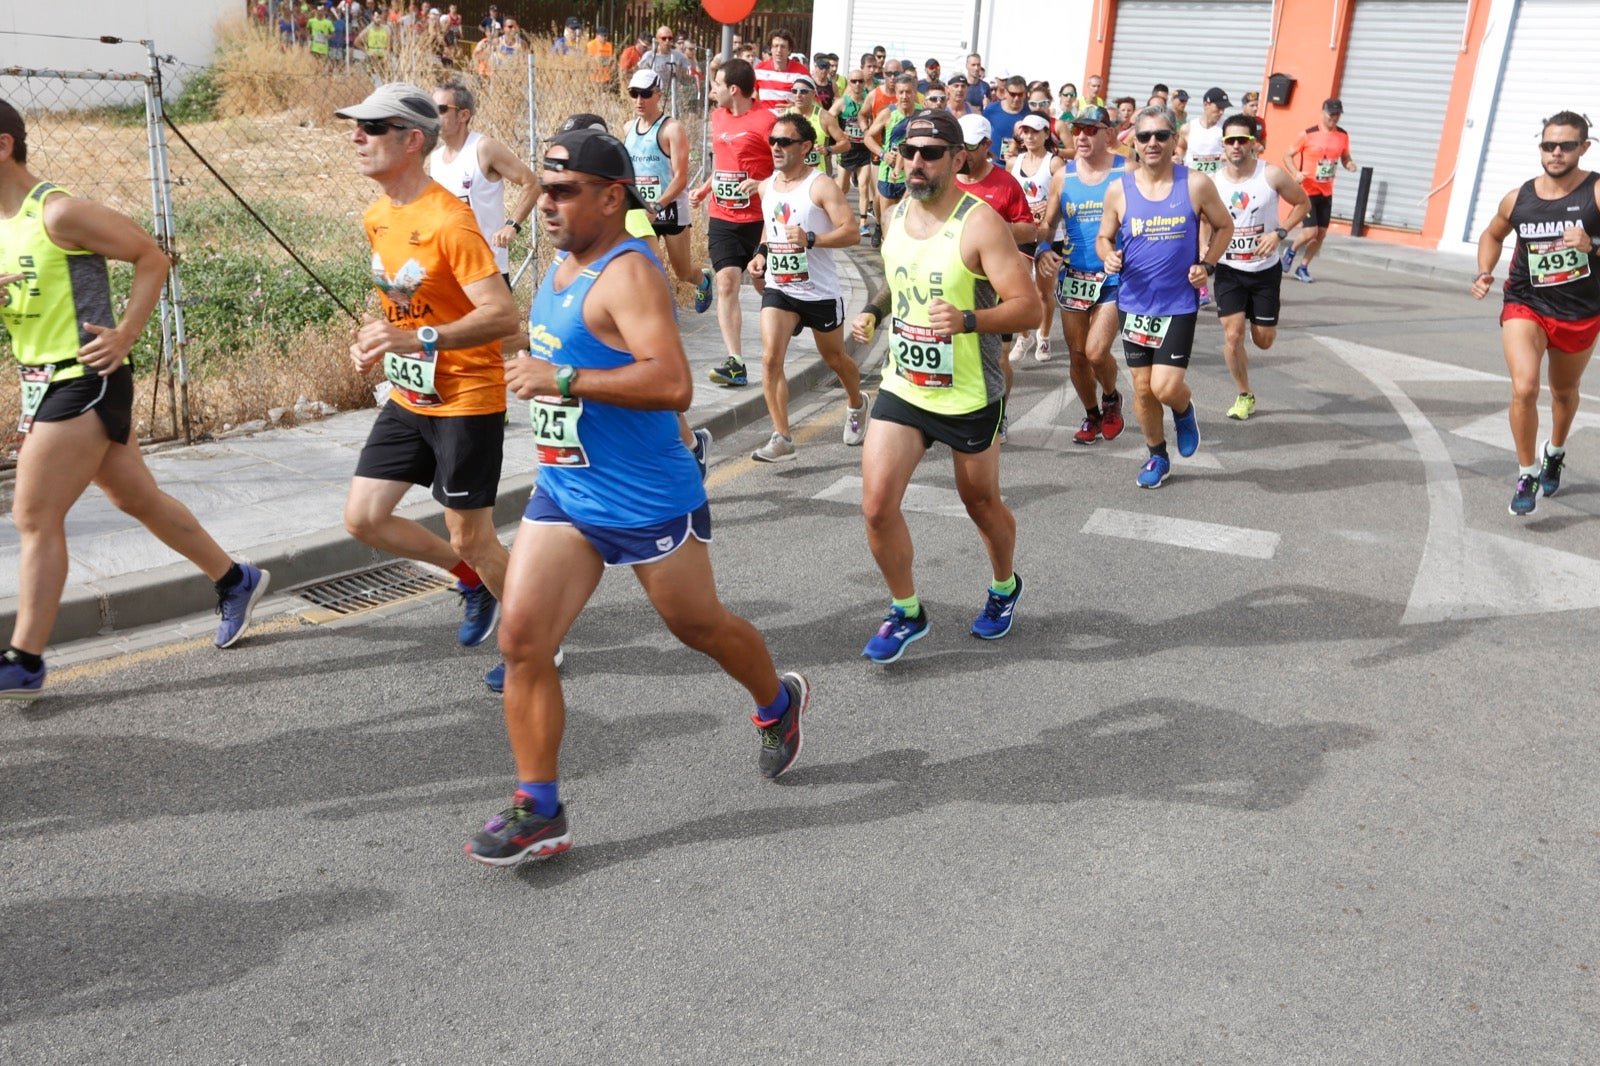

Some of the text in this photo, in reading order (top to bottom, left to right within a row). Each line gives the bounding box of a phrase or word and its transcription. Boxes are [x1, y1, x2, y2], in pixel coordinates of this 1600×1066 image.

[1197, 161, 1217, 172] 273
[636, 186, 656, 200] 65
[717, 183, 744, 198] 552
[1078, 200, 1104, 209] olim
[1145, 215, 1187, 227] olimpo
[1519, 219, 1585, 234] GRANADA
[771, 255, 800, 271] 943
[1538, 250, 1579, 271] 493
[1070, 280, 1097, 298] 518
[1133, 314, 1162, 333] 536
[898, 341, 942, 370] 299
[391, 357, 424, 388] 543
[533, 407, 567, 441] 25
